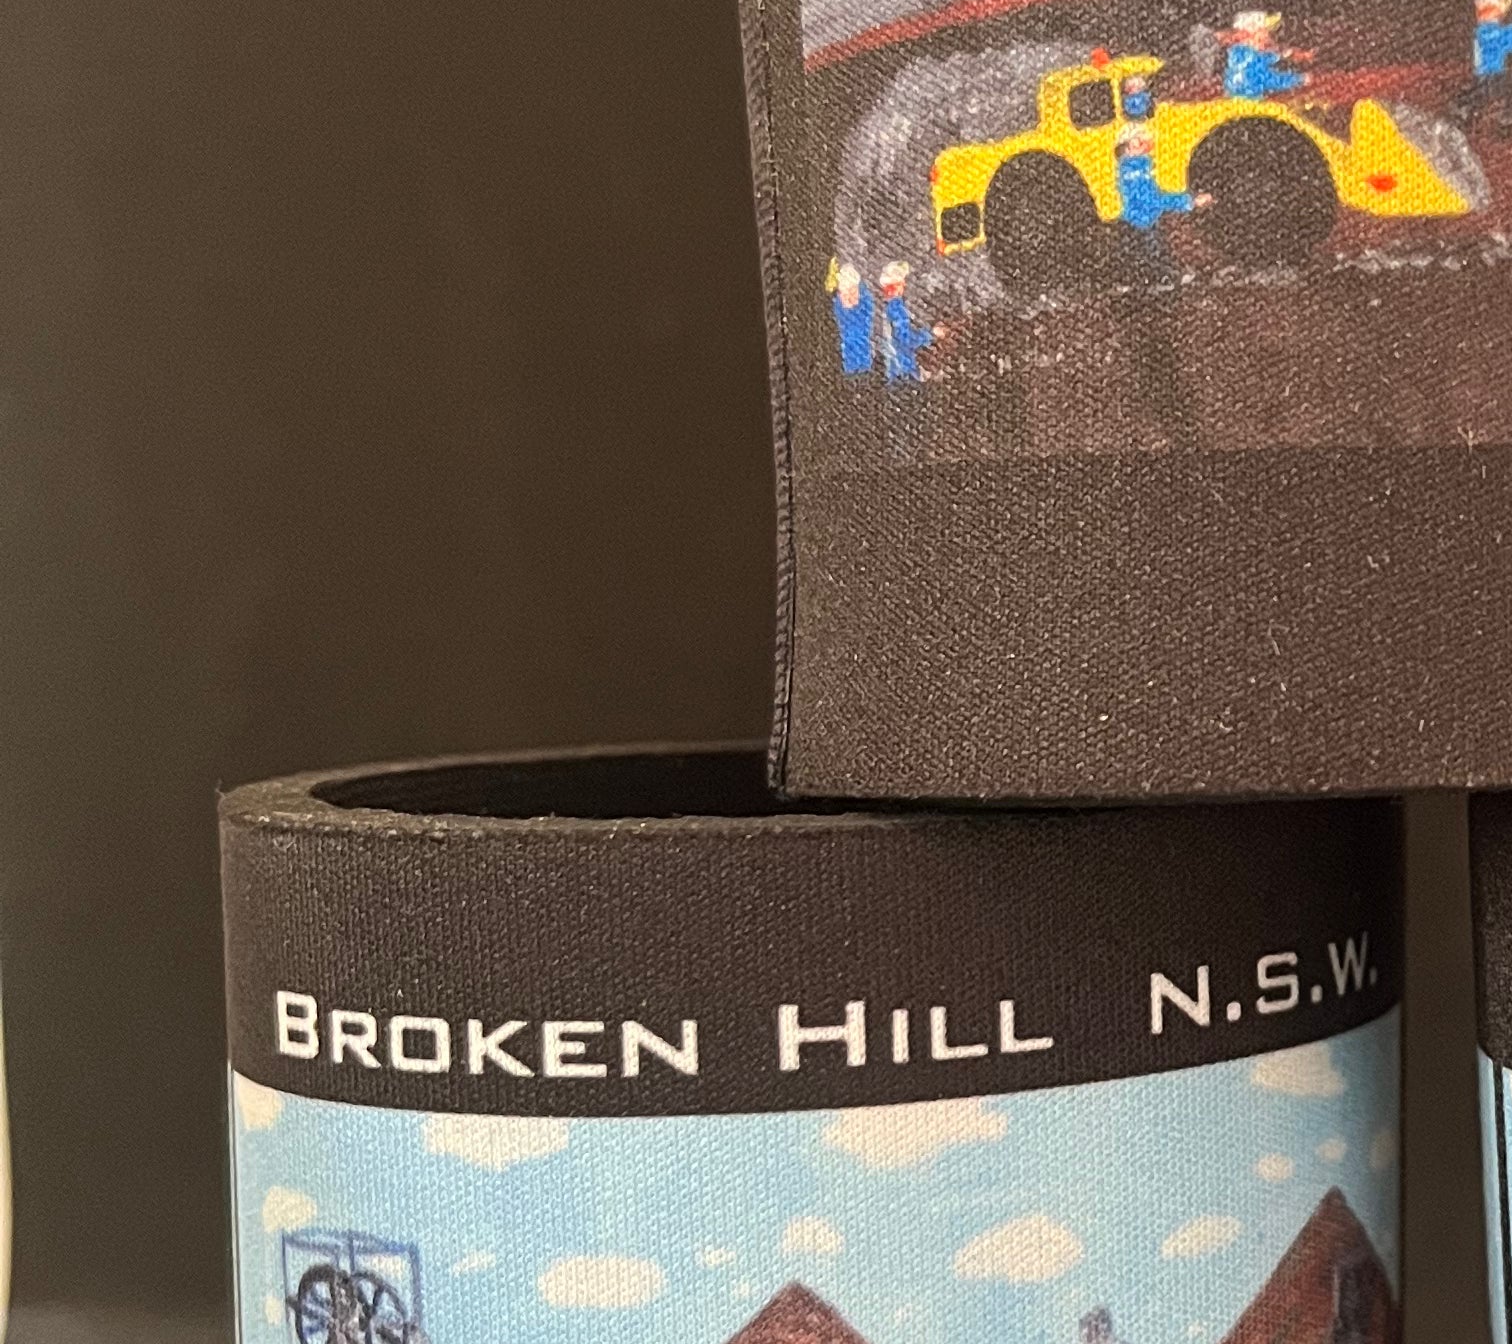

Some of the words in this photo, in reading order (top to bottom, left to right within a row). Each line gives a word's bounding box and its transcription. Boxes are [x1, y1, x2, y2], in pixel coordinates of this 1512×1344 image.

[275, 989, 700, 1079] BROKEN
[777, 999, 1055, 1072] HILL
[1149, 930, 1379, 1036] N.S.W.
